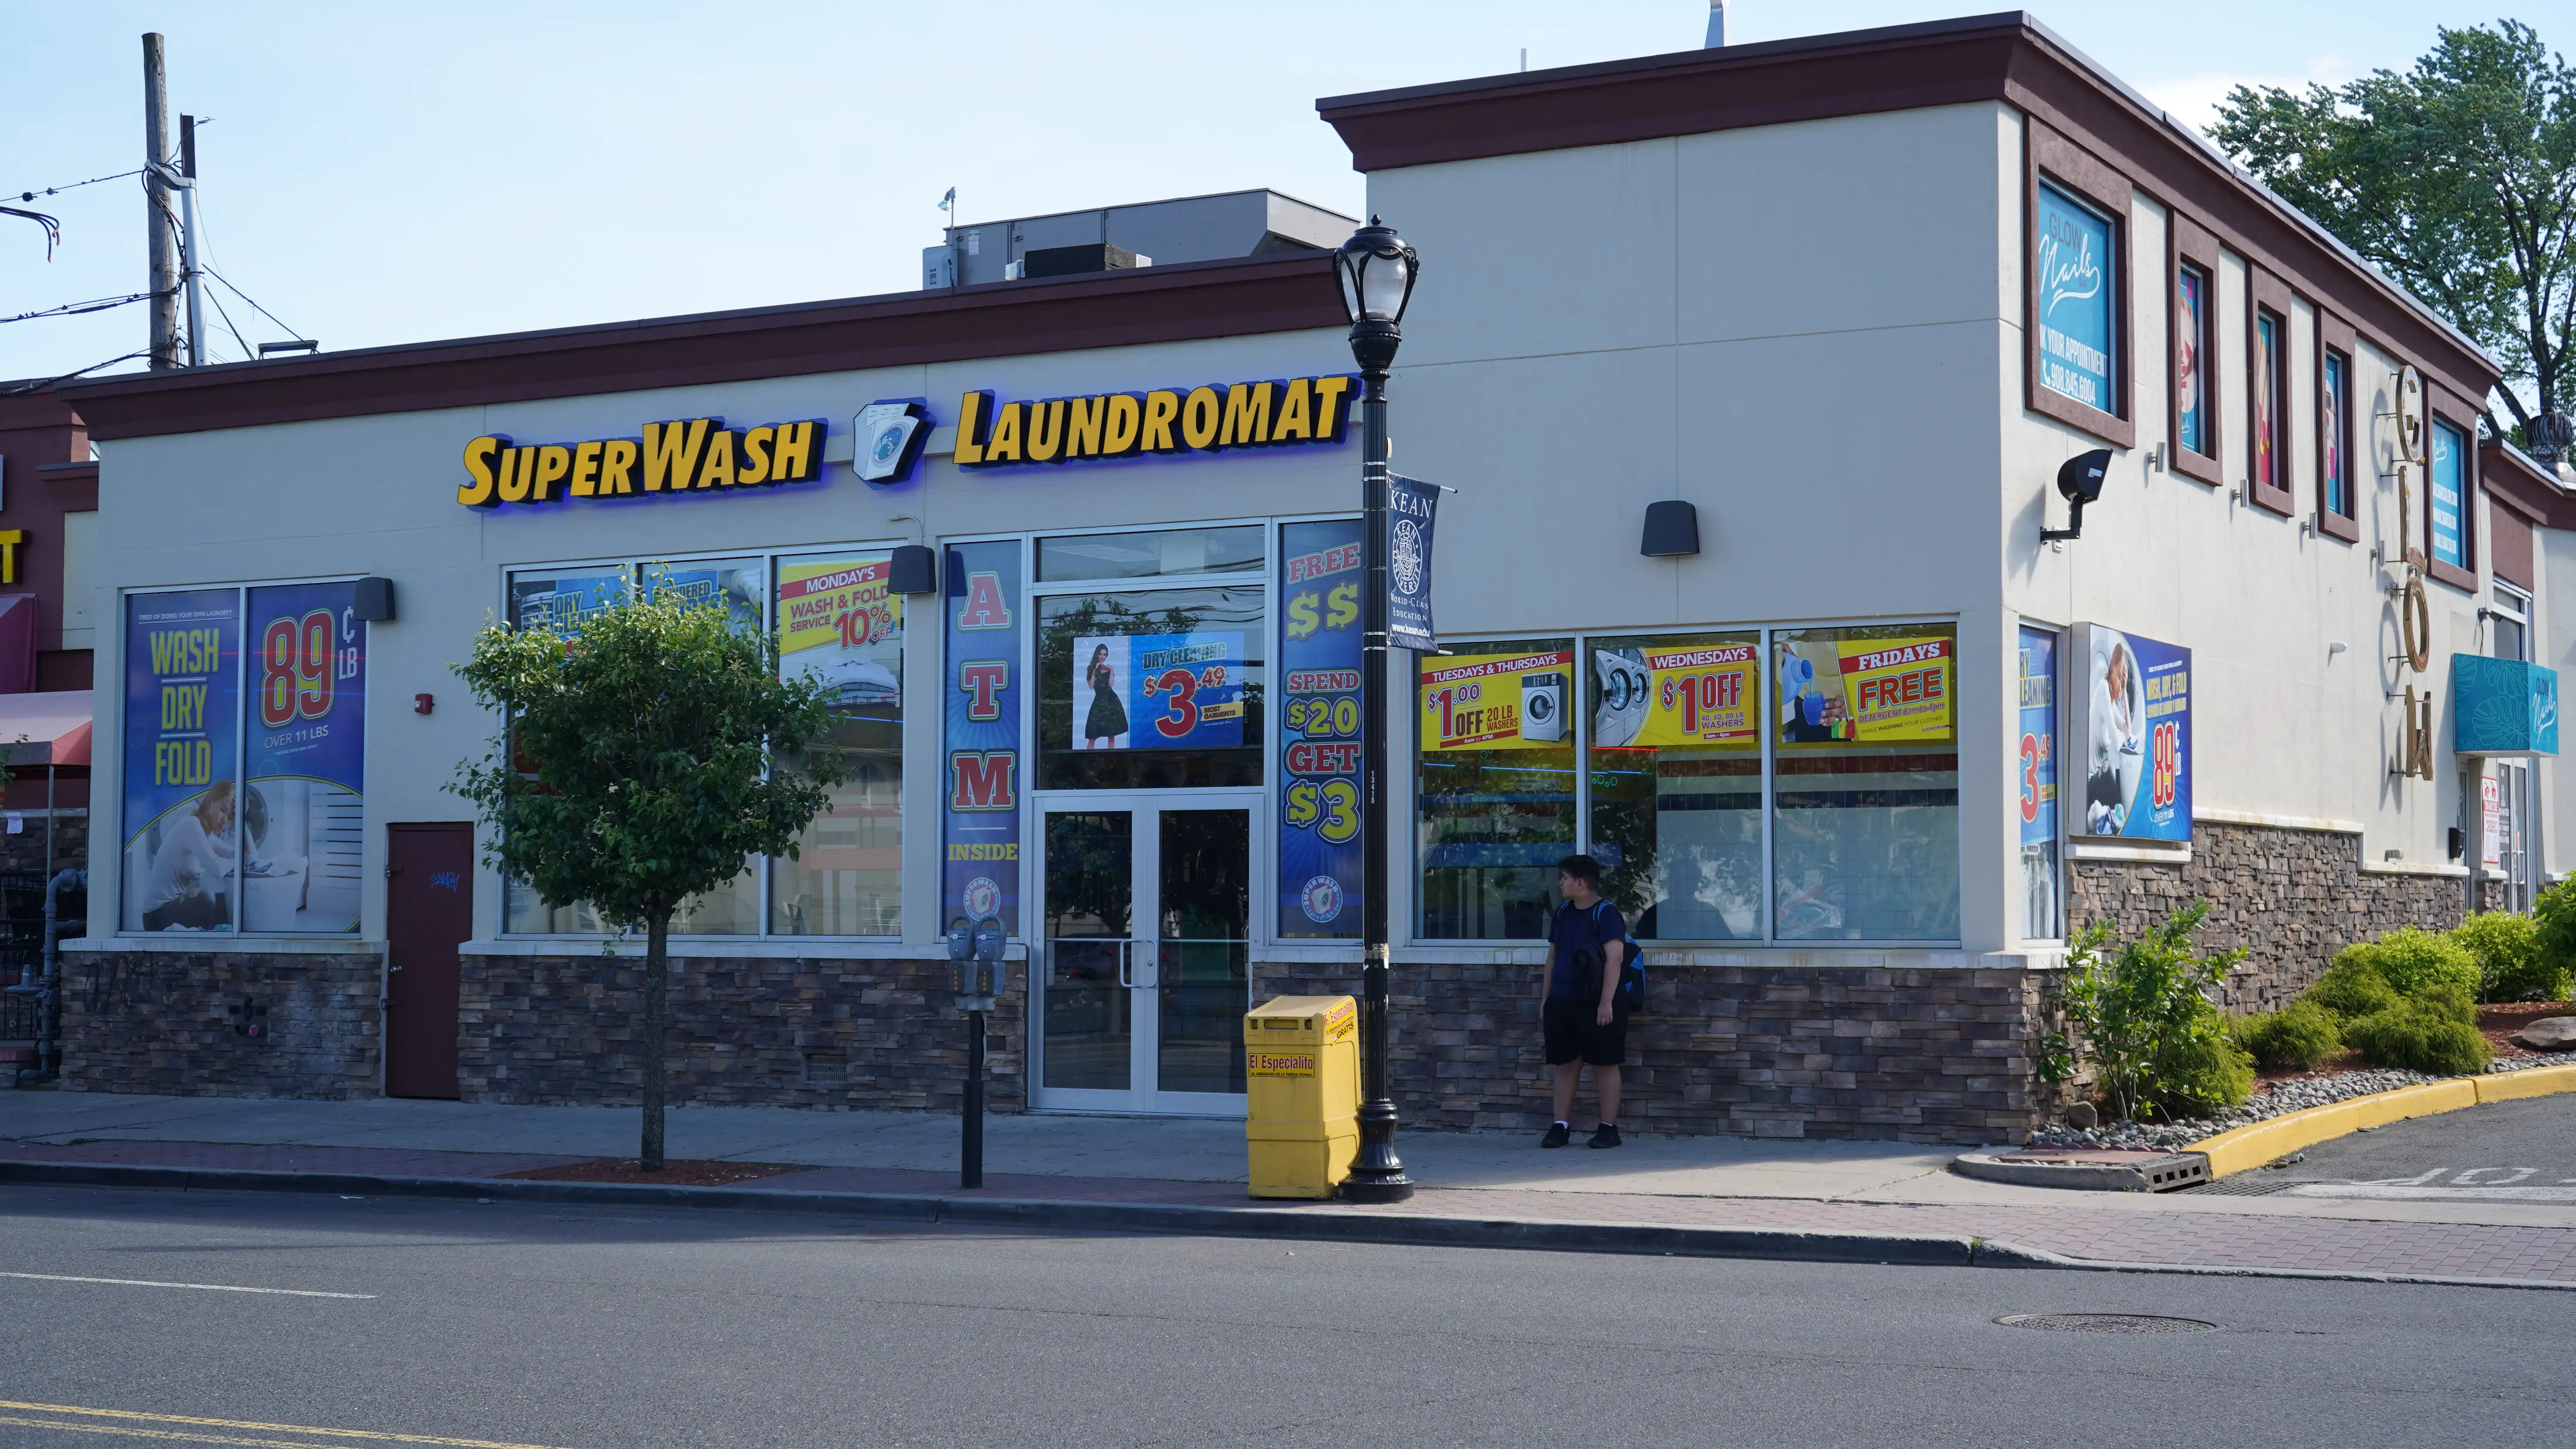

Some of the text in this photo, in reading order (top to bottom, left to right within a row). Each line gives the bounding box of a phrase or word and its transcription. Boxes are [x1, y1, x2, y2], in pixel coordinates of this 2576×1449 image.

[2050, 212, 2081, 252] GLOW
[2039, 233, 2100, 309] Nails
[2047, 326, 2064, 358] YOUR
[2066, 336, 2107, 378] APPOINTMENT
[2051, 362, 2096, 405] 908.845.6004
[951, 375, 1352, 465] LAUNDROMAT
[457, 418, 818, 506] SUPERWASH
[1390, 490, 1433, 518] KEAN
[1397, 522, 1417, 540] KEAN
[1287, 542, 1360, 585] FREE
[1394, 550, 1421, 591] UNIVERSITY
[806, 567, 875, 593] MONDAY'S
[553, 591, 583, 616] DRY
[790, 584, 890, 619] WASH & FOLD
[1393, 607, 1427, 621] EDUCATION
[790, 602, 893, 651] SERVICE 10%
[871, 627, 891, 641] OFF
[1392, 624, 1431, 637] www.kean.edu
[150, 628, 219, 675] WASH
[339, 647, 357, 680] LB
[1142, 641, 1227, 670] DRY CLEANING
[1654, 648, 1748, 668] WEDNESDAYS
[1859, 643, 1940, 670] FRIDAYS
[2020, 648, 2031, 679] RY
[261, 608, 335, 727] 89
[1287, 670, 1361, 693] SPEND
[1433, 654, 1557, 682] TUESDAYS & THURSDAYS
[951, 571, 1016, 810] ATM
[1857, 666, 1944, 713] FREE
[2020, 675, 2052, 708] LEANING
[2147, 677, 2161, 702] WASH,
[2162, 674, 2172, 700] DRY,
[2176, 671, 2187, 695] FOLD
[2536, 677, 2549, 696] GLOW
[161, 685, 207, 730] DRY
[1204, 710, 1236, 719] GARMENTS
[1487, 705, 1513, 721] 20 LB
[1662, 671, 1744, 734] $1 OFF
[1859, 709, 1902, 723] DETERGENT
[1903, 707, 1918, 715] 6am
[1927, 703, 1944, 712] 4pm
[2533, 682, 2556, 737] Nails
[1287, 697, 1360, 737] $20
[1455, 709, 1483, 737] OFF
[1487, 717, 1518, 731] WASHERS
[1701, 719, 1744, 729] WASHERS
[1878, 723, 1903, 731] WASHING
[1920, 716, 1943, 724] CLOTHES
[265, 725, 328, 749] OVER 11 LBS
[155, 740, 211, 785] FOLD
[1287, 742, 1361, 774] GET
[2153, 721, 2175, 809] 89
[2175, 752, 2181, 776] LB
[1286, 778, 1361, 843] $3
[948, 843, 1018, 861] INSIDE
[966, 879, 996, 905] SUPERWASH
[1304, 878, 1339, 905] SUPERWASH
[1330, 1000, 1353, 1024] Especialito
[1337, 1022, 1354, 1038] GRATIS
[1250, 1055, 1313, 1071] El Especialito
